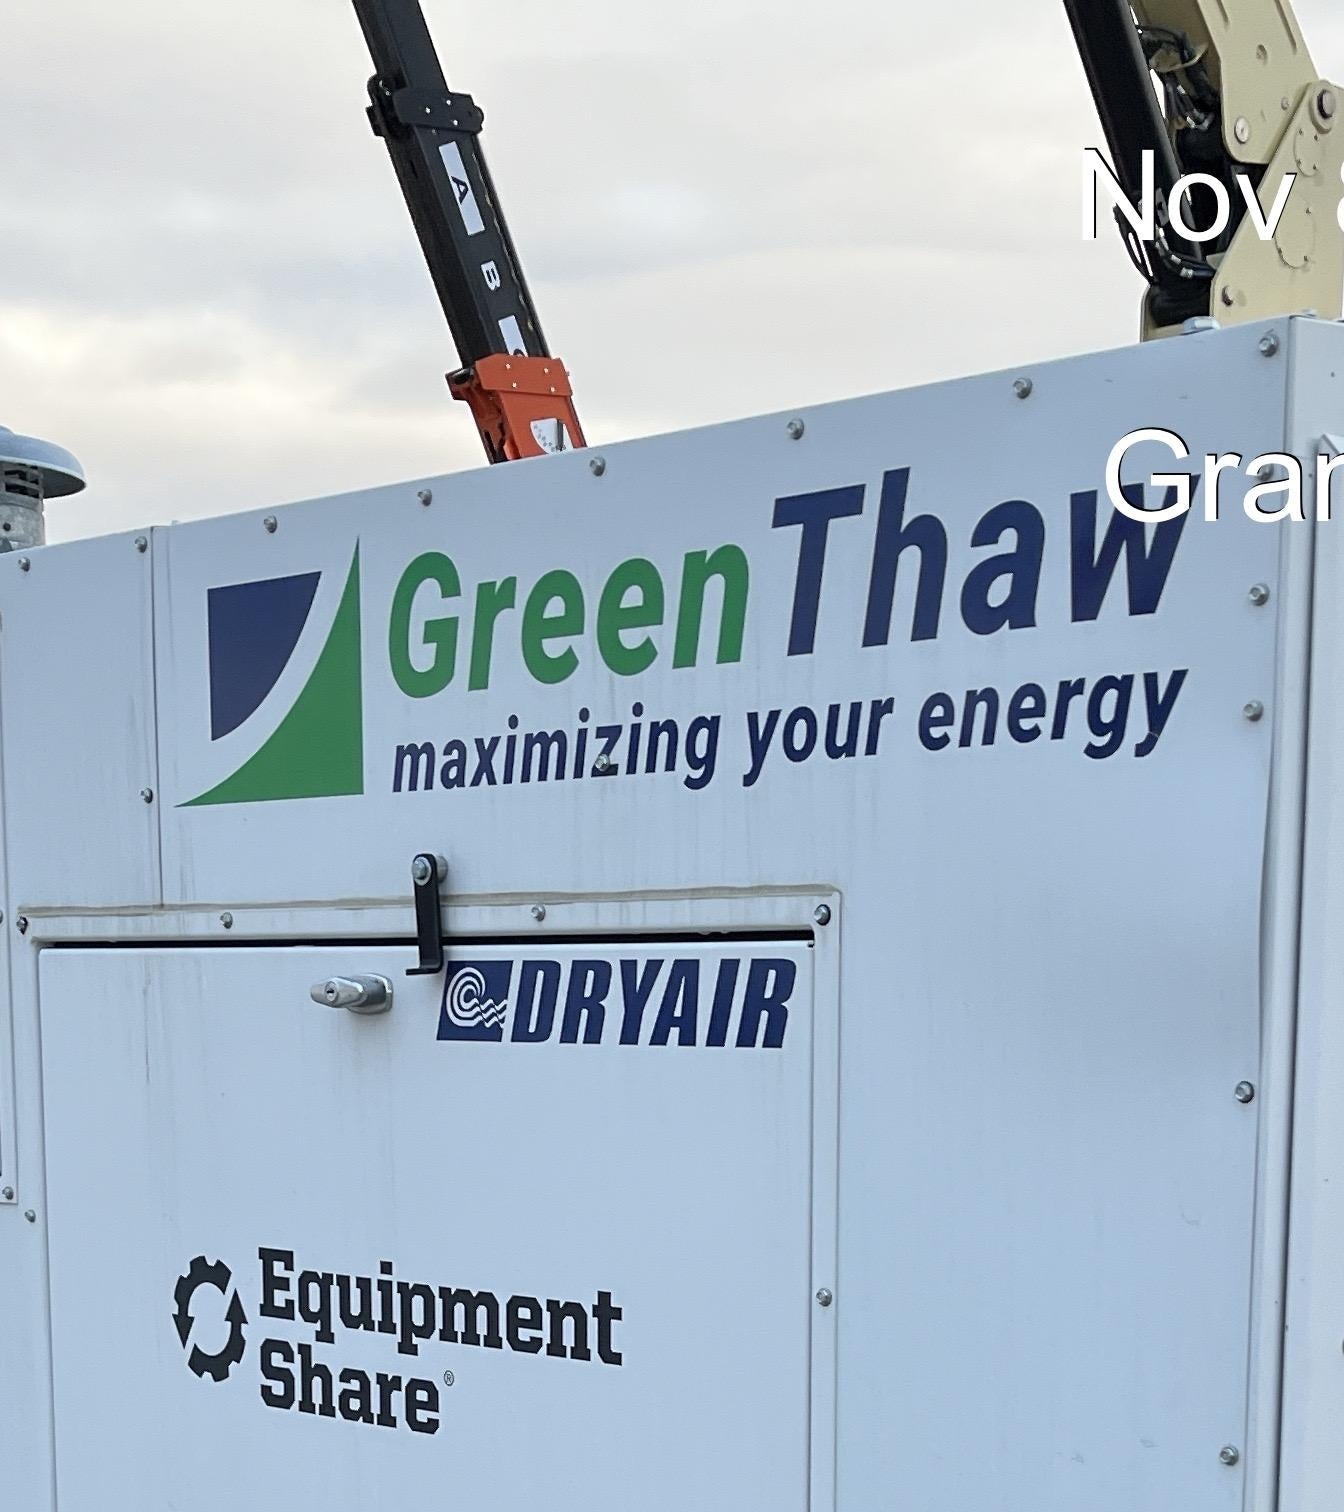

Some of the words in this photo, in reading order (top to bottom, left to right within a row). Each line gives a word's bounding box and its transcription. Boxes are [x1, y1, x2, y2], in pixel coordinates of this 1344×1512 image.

[392, 702, 721, 792] maximizing
[742, 697, 895, 788] your
[918, 668, 1189, 760] energy
[509, 958, 797, 1048] DRYAIR
[258, 1246, 623, 1366] Equipment
